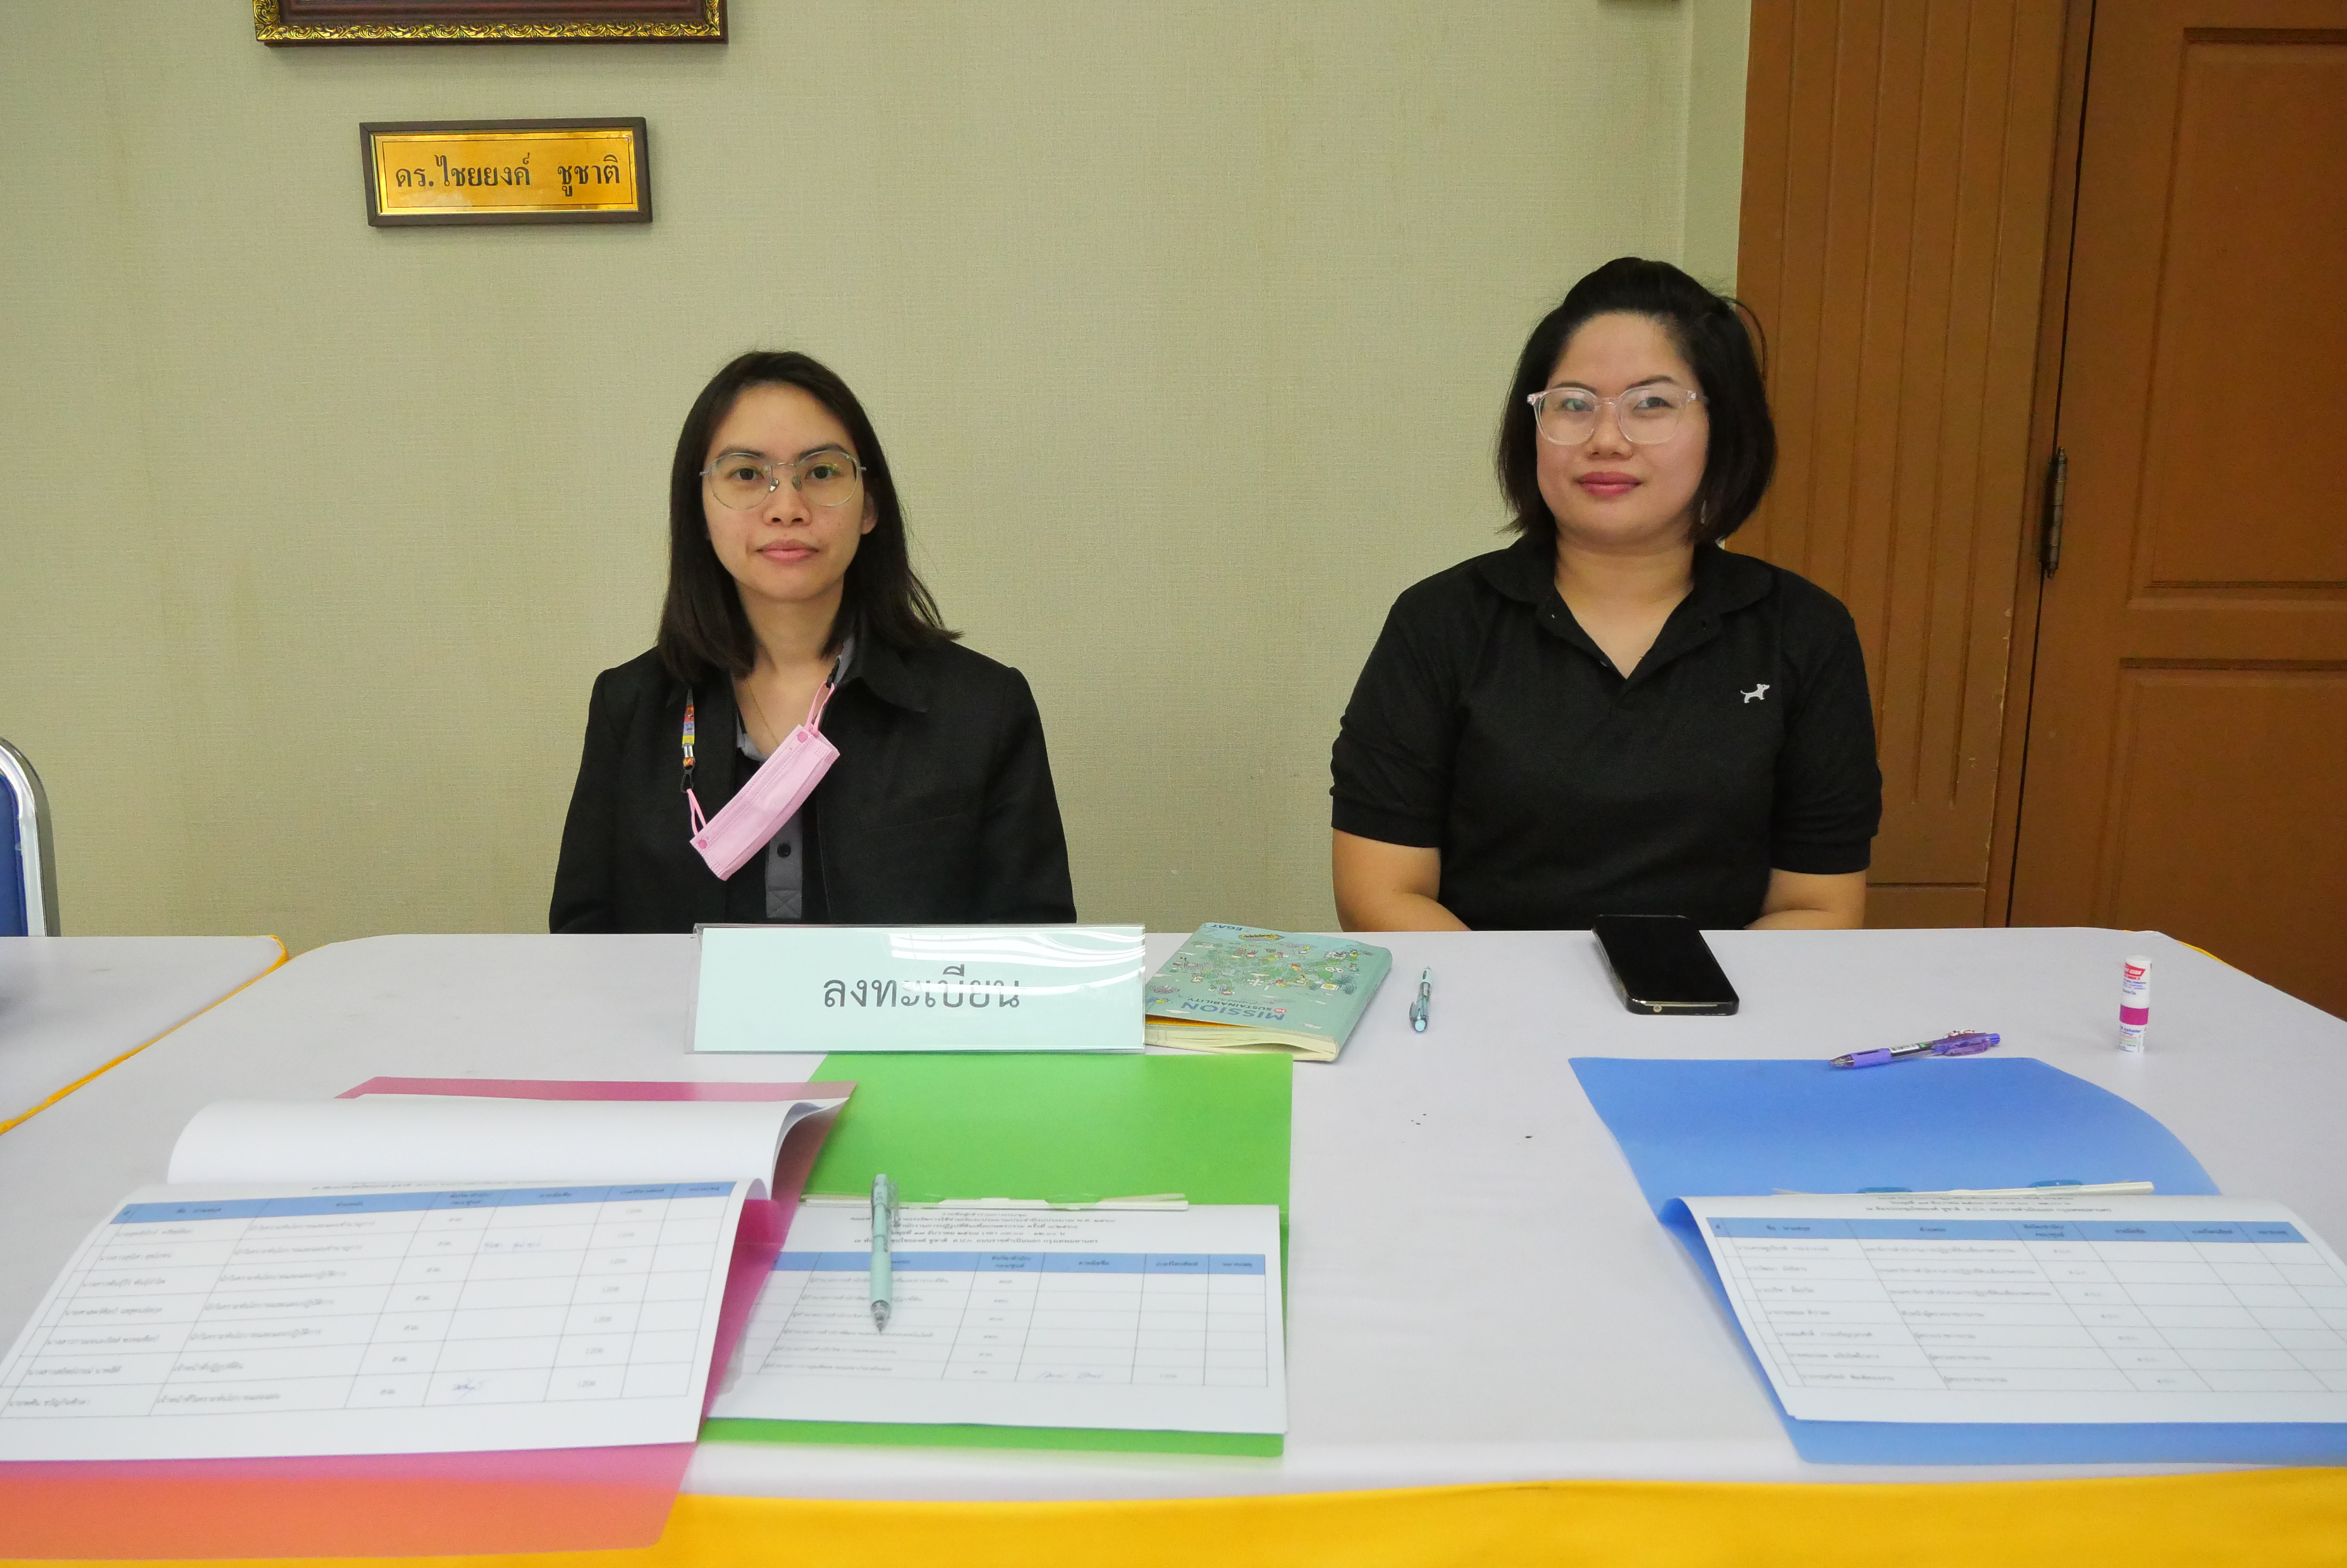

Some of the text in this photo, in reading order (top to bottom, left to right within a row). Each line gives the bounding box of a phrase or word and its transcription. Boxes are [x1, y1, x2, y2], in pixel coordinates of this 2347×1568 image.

[396, 152, 620, 197] ดร.ไชยยงค์ ชูชาติ
[823, 964, 1020, 1008] ลงทะเบียน
[1180, 1001, 1285, 1021] MISSION
[1187, 997, 1273, 1011] SUSTAINABILITY
